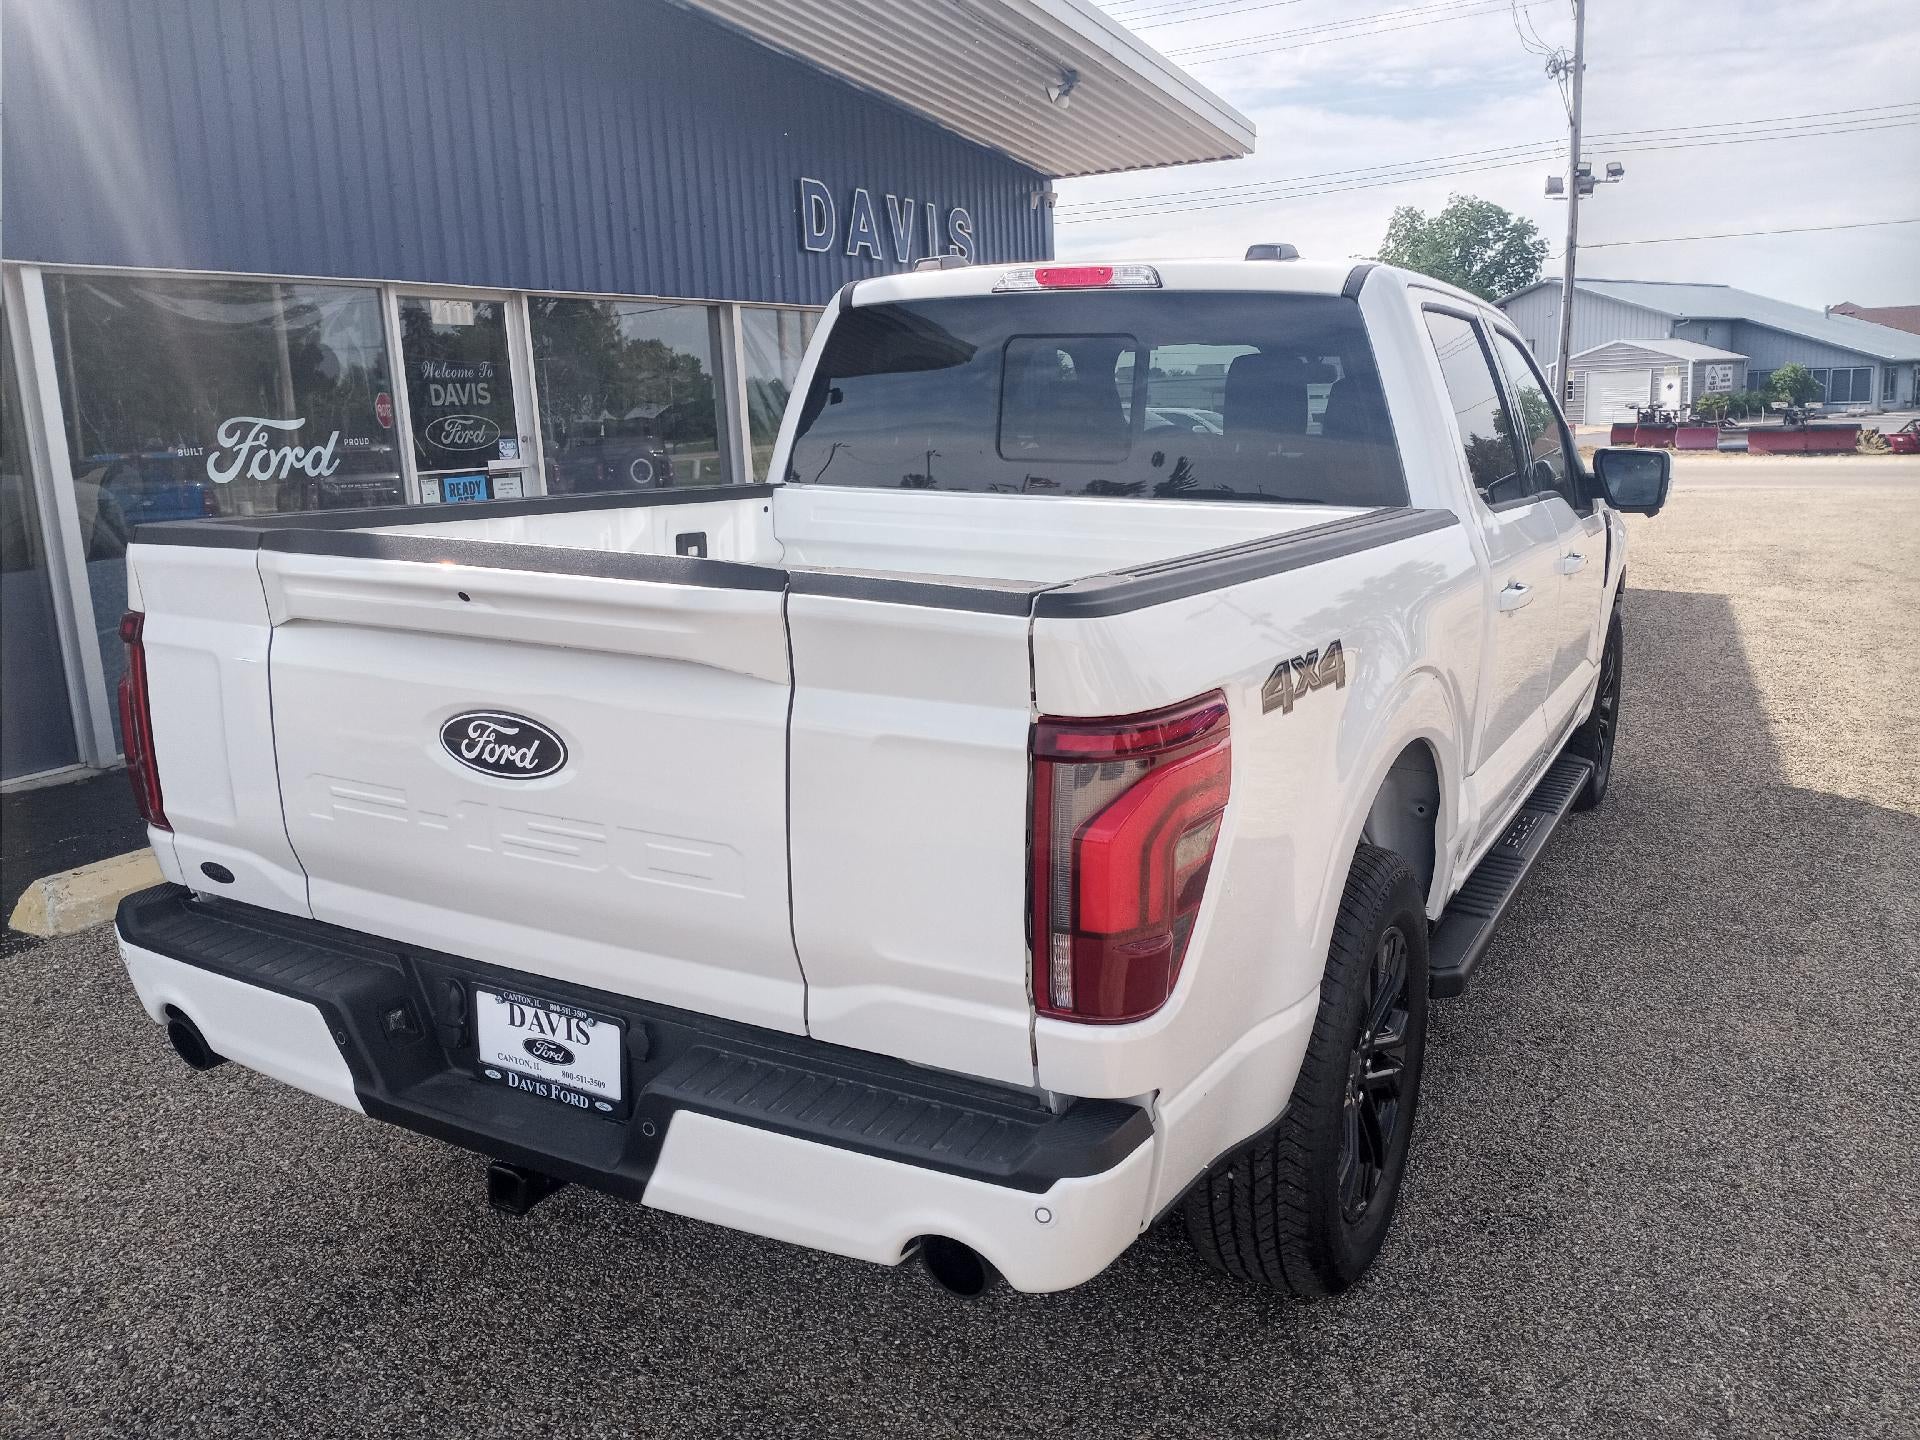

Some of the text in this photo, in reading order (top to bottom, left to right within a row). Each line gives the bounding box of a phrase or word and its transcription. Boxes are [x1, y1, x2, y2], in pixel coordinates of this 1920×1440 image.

[801, 177, 975, 264] DAVIS
[420, 360, 493, 379] Welcome To
[429, 383, 491, 406] DAVIS
[343, 437, 370, 446] PROUD
[441, 418, 486, 444] Ford
[177, 447, 204, 457] BUILT
[206, 416, 341, 484] Ford
[500, 441, 516, 450] Push
[448, 480, 481, 497] READY
[460, 719, 540, 771] Ford
[503, 991, 533, 1006] CANTON,
[508, 1002, 591, 1046] DAVIS
[497, 1052, 532, 1069] CANTON,
[532, 1040, 565, 1063] Ford
[507, 1071, 548, 1097] DAVIS
[550, 1083, 589, 1109] FORD
[561, 1070, 606, 1089] 800-511-3509
